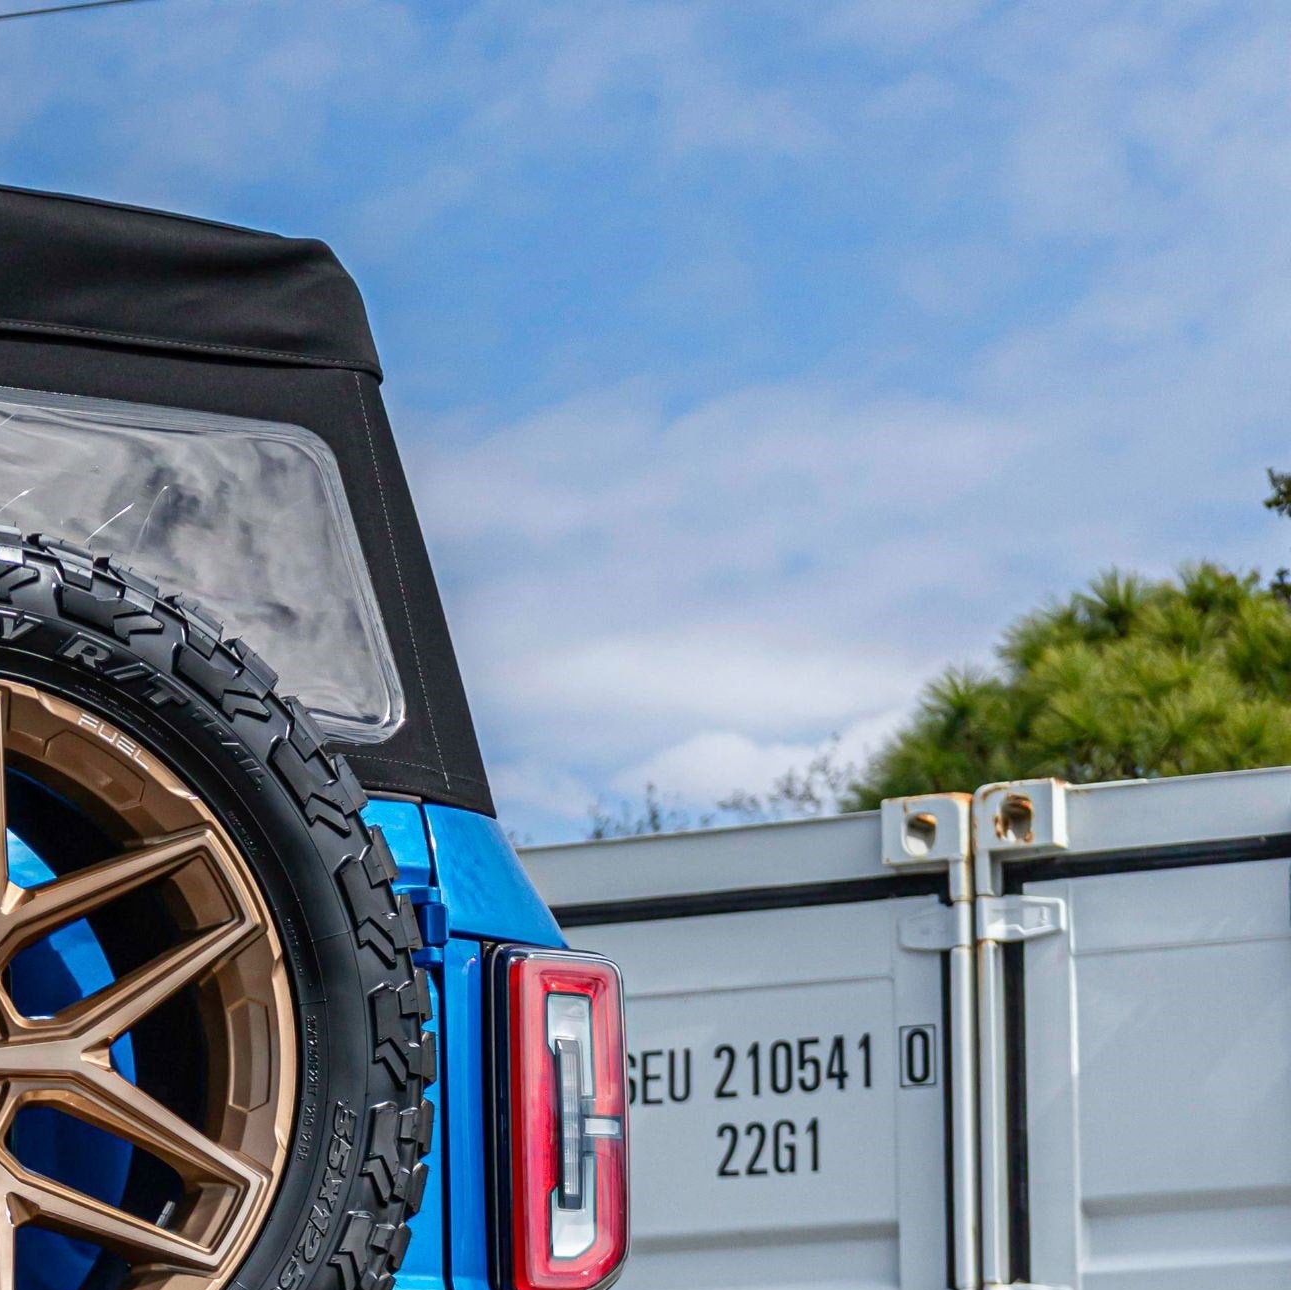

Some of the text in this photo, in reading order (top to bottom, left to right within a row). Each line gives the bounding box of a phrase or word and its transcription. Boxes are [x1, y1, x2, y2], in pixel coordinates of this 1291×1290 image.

[60, 631, 190, 706] R/T
[77, 712, 150, 771] FUEL
[714, 1032, 872, 1099] 210541
[717, 1117, 821, 1177] 22G1
